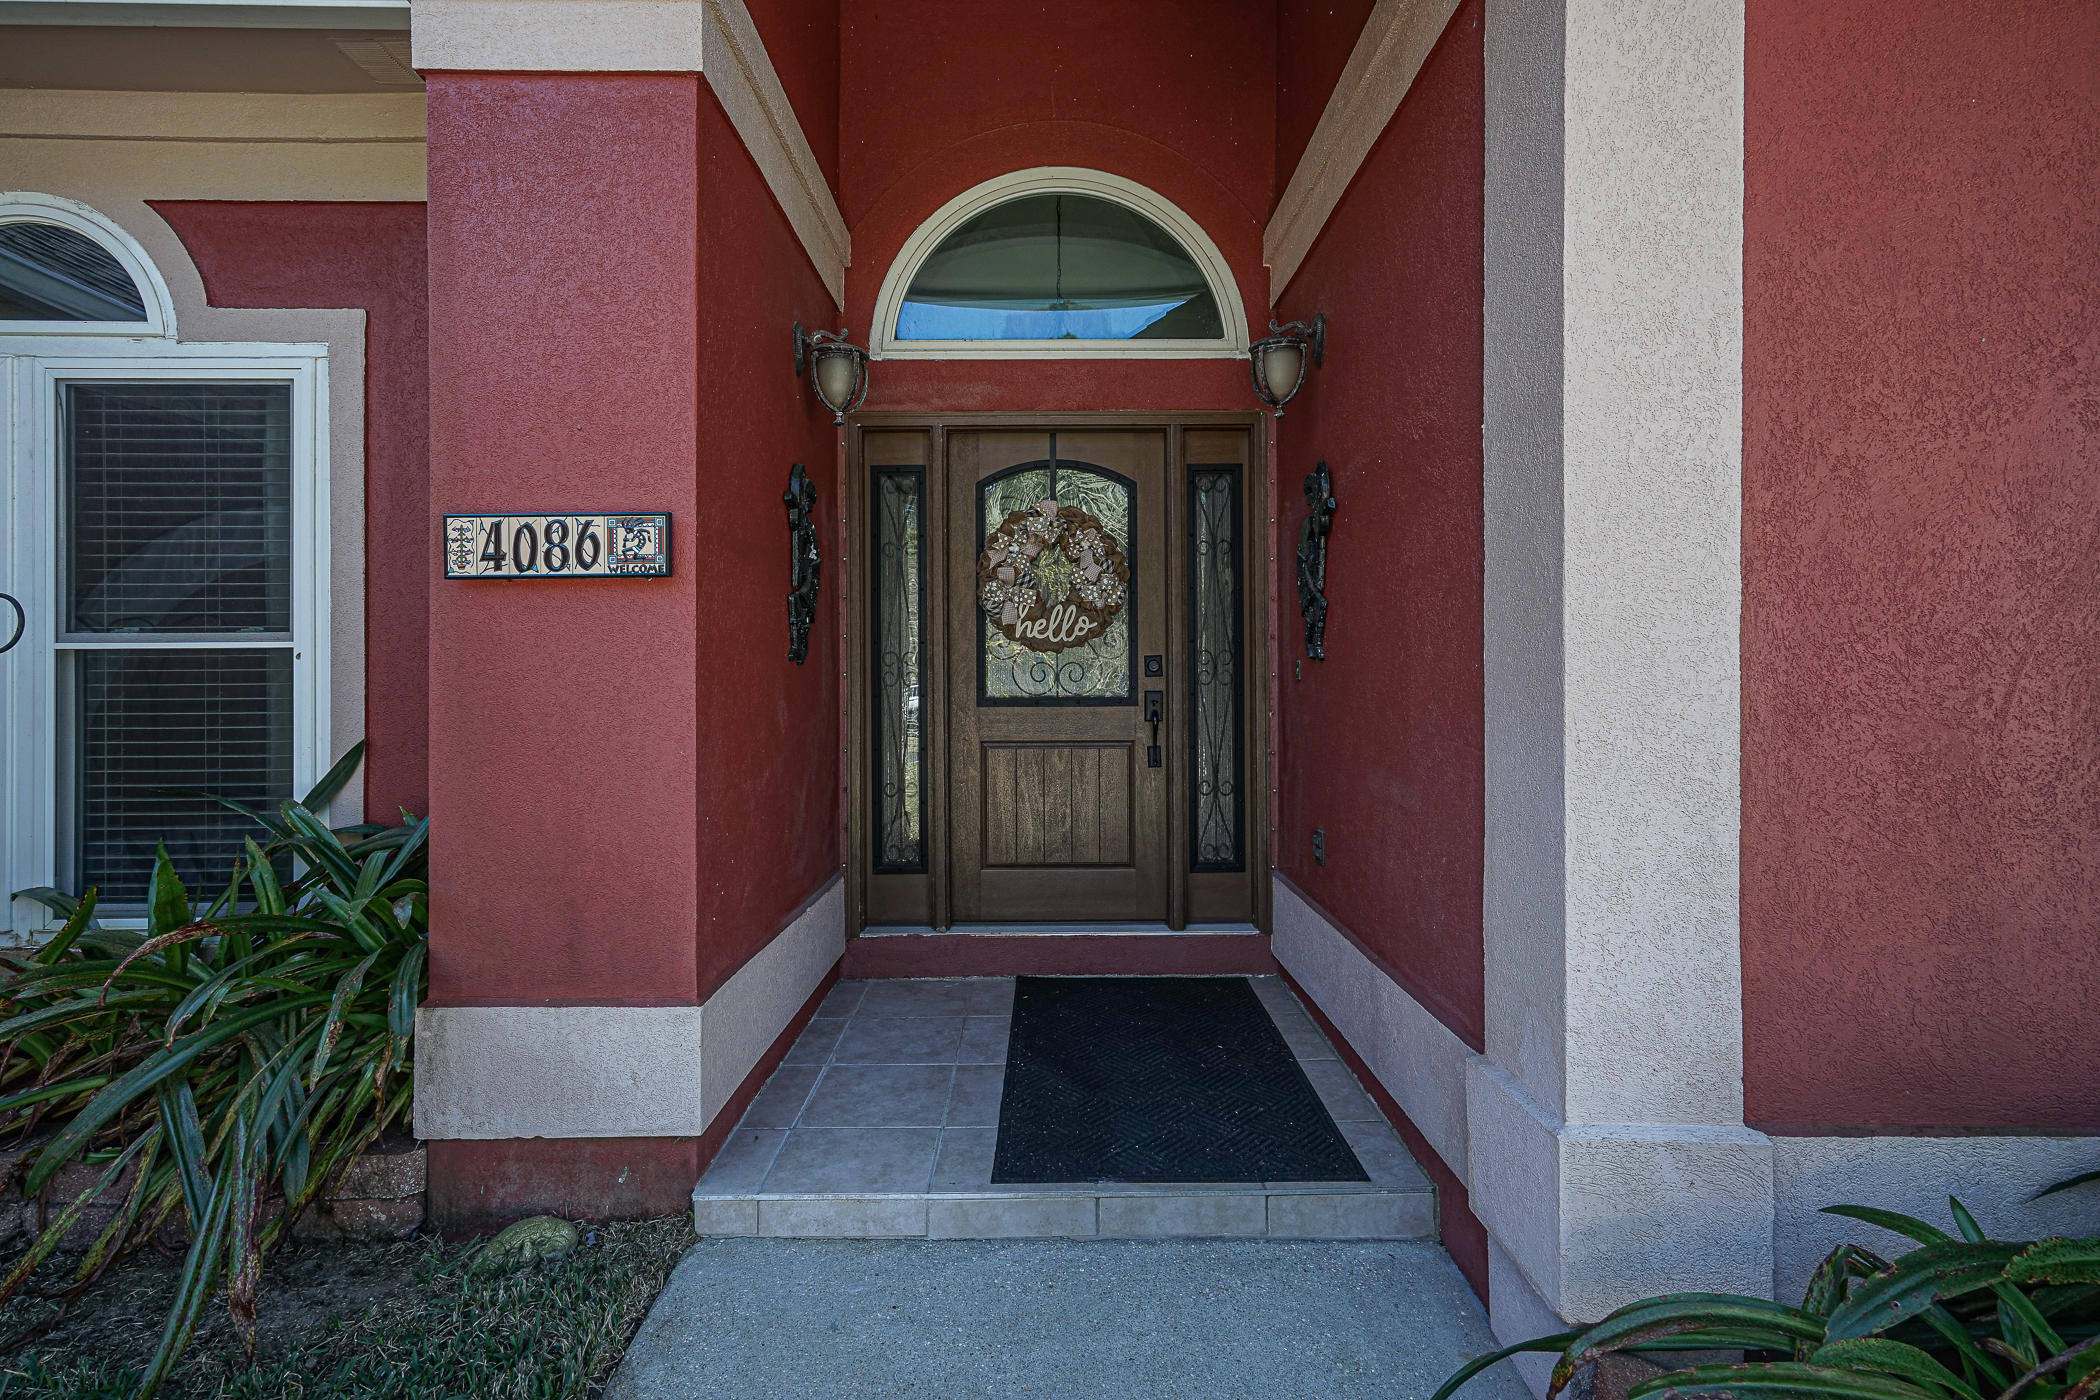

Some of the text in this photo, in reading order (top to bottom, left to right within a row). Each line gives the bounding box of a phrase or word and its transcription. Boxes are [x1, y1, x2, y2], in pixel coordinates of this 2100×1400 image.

[479, 519, 601, 573] 4086
[607, 563, 665, 574] WELCOME
[1015, 603, 1098, 643] hello
